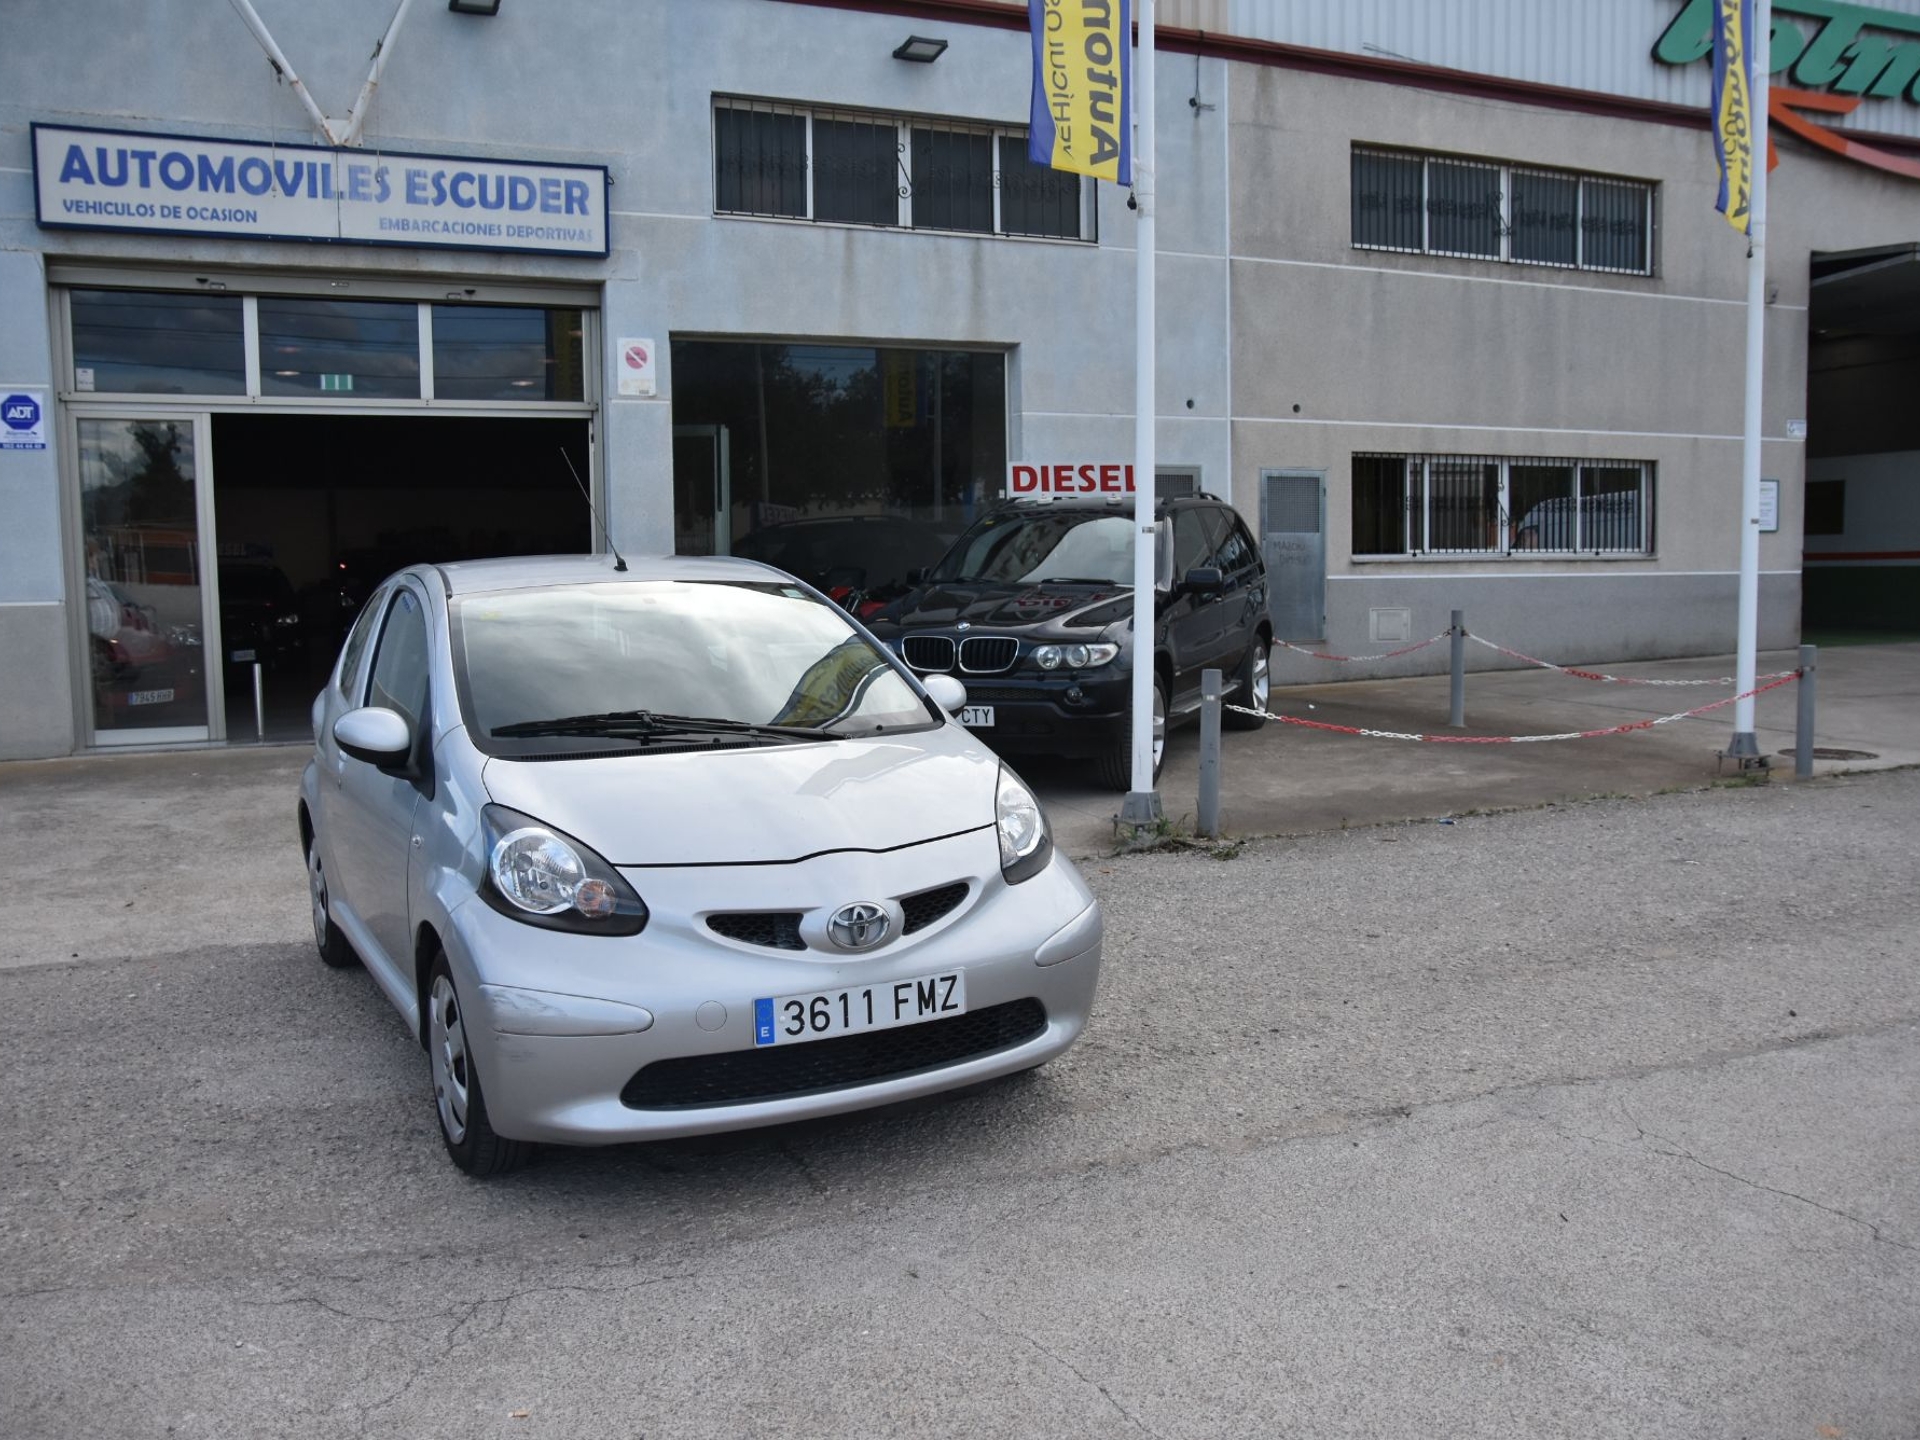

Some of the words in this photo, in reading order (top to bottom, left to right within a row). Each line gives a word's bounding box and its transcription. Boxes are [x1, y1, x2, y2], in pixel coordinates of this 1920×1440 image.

[59, 144, 392, 204] AUTOMOVILES
[405, 168, 590, 216] ESCUDER
[63, 199, 156, 218] VEHICULOS
[160, 205, 182, 219] DE
[187, 207, 258, 223] OCASION
[379, 217, 502, 237] EMBARCACIONES
[506, 225, 593, 243] DEPORTIVAS
[7, 406, 35, 419] ADT
[1012, 464, 1137, 493] DIESEL
[961, 708, 990, 724] CTY
[783, 989, 874, 1036] 3611
[893, 974, 959, 1020] FMZ
[761, 1027, 770, 1038] E
